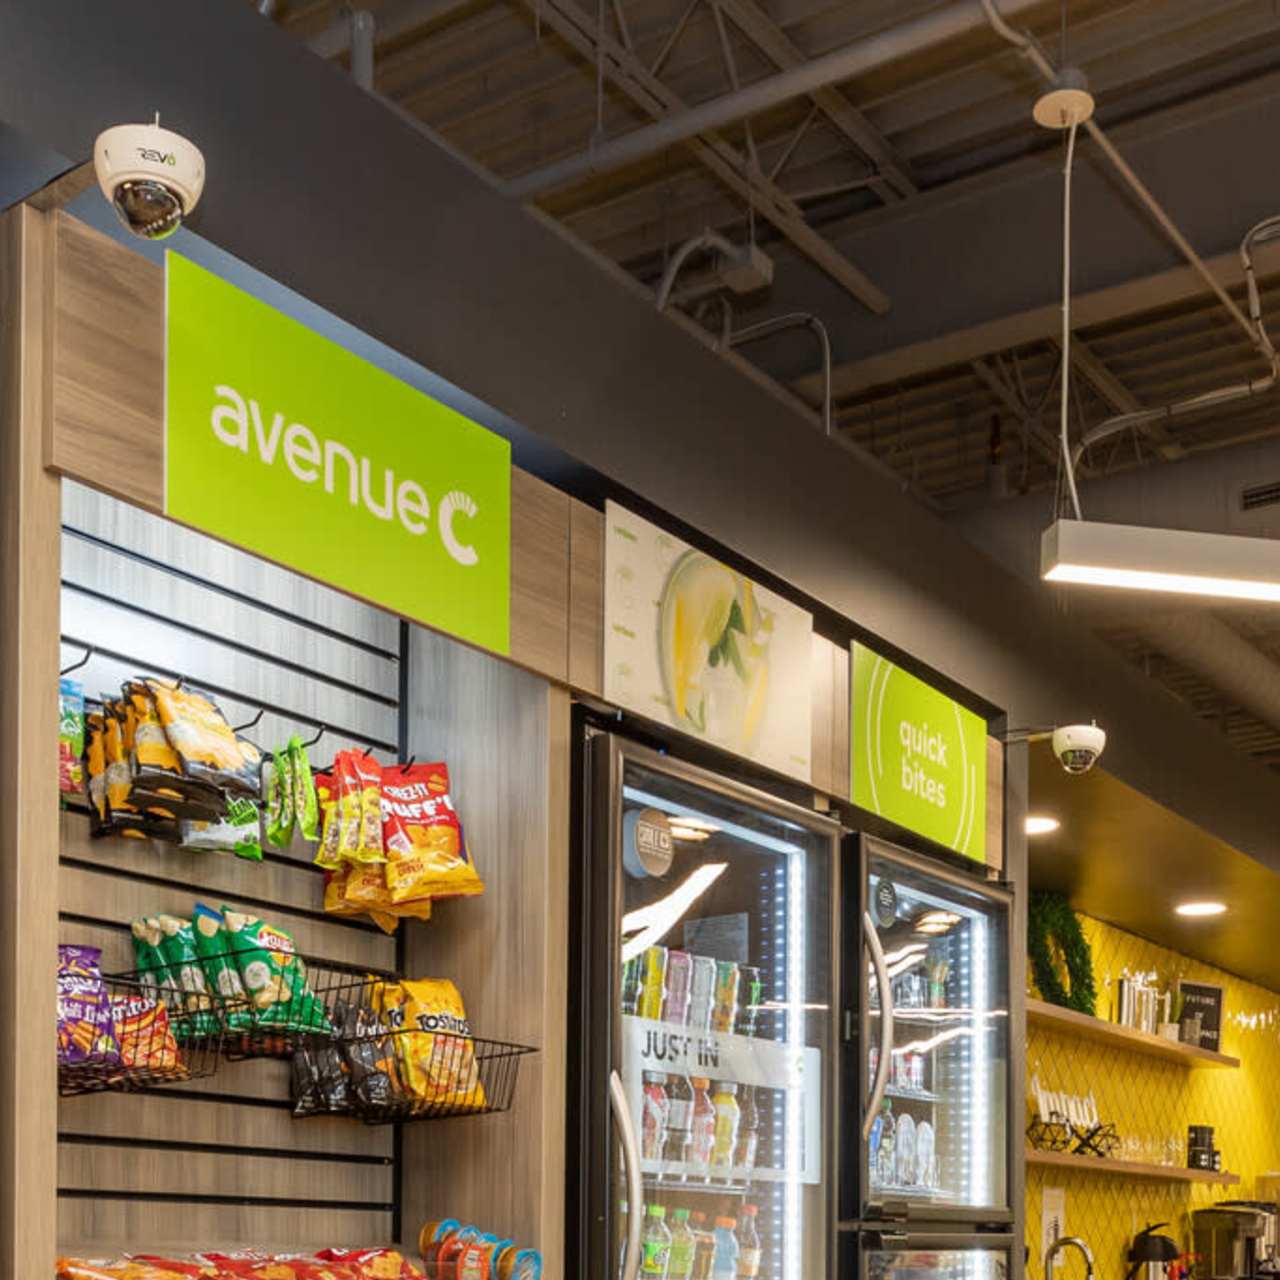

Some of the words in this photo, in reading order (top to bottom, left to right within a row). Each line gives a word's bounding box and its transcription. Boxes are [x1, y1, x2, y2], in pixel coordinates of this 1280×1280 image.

[211, 384, 430, 535] avenue
[899, 720, 947, 768] quick
[901, 753, 946, 809] bites
[110, 996, 157, 1021] ritos
[642, 1030, 692, 1063] JUST
[697, 1038, 720, 1068] IN
